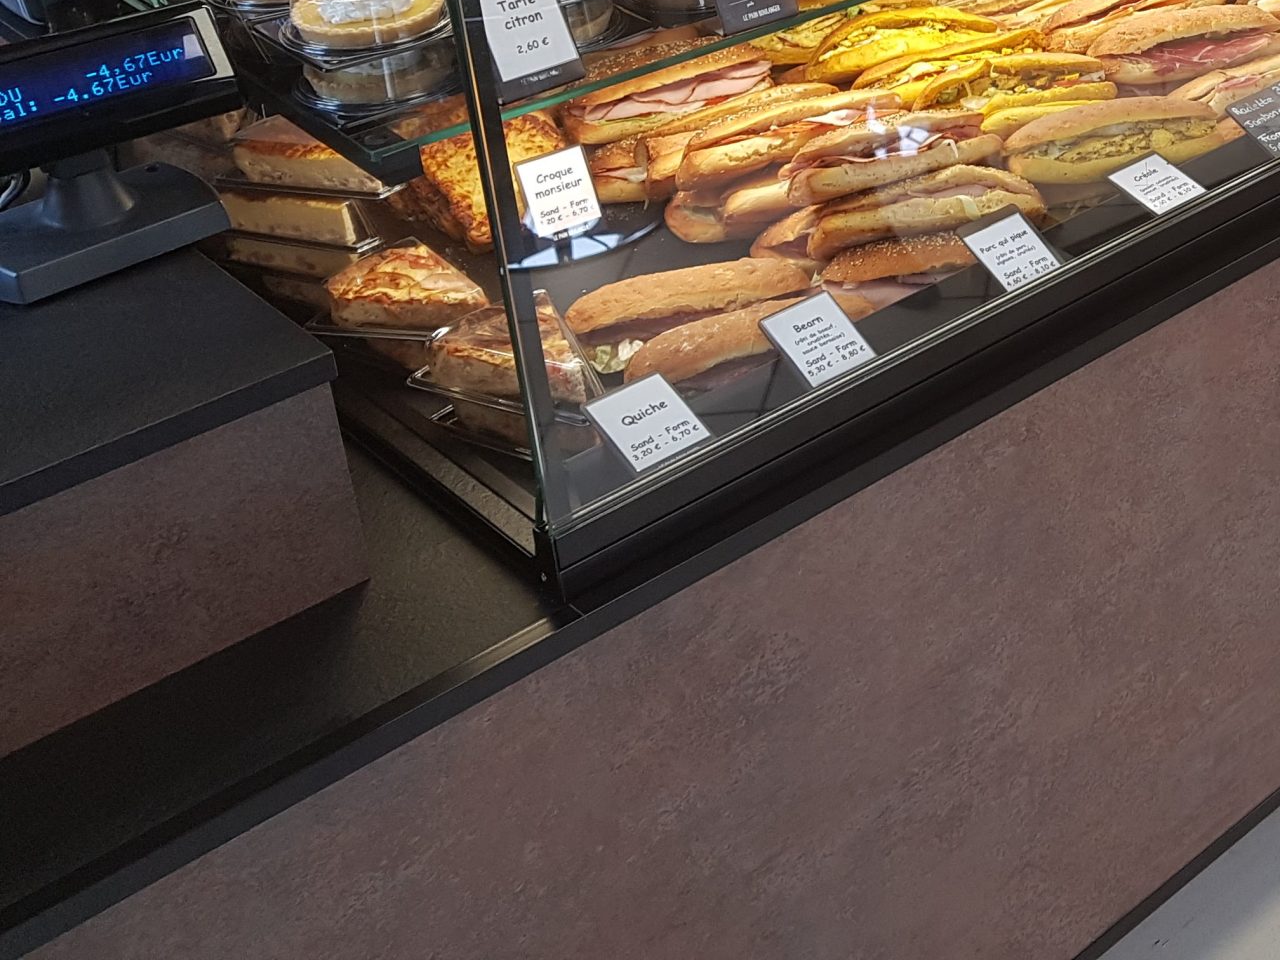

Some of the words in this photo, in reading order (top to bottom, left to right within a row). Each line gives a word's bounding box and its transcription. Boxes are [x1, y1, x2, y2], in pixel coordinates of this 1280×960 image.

[504, 10, 544, 31] citron
[516, 39, 540, 55] 2,60
[542, 36, 550, 46] €
[86, 47, 183, 79] -4,67Eur
[52, 71, 153, 104] -4.67Eur
[1231, 97, 1274, 116] Raclette
[1243, 110, 1278, 128] Jambon
[536, 167, 574, 184] Croque
[535, 178, 583, 200] monsieur
[540, 206, 560, 218] Sand
[979, 243, 997, 255] Porc
[998, 238, 1009, 250] qui
[1010, 228, 1029, 243] pique
[1003, 266, 1022, 280] Sand
[1028, 255, 1049, 269] Form
[792, 316, 824, 334] Bearn
[805, 353, 827, 368] Sand
[835, 339, 858, 354] Form
[807, 364, 826, 378] 5,30
[840, 348, 859, 362] 8,80
[621, 400, 668, 427] Quiche
[630, 435, 655, 452] Sand
[664, 419, 690, 435] Form
[632, 447, 653, 462] 3,20
[654, 442, 662, 450] €
[671, 428, 691, 443] 6,70
[692, 423, 700, 432] €
